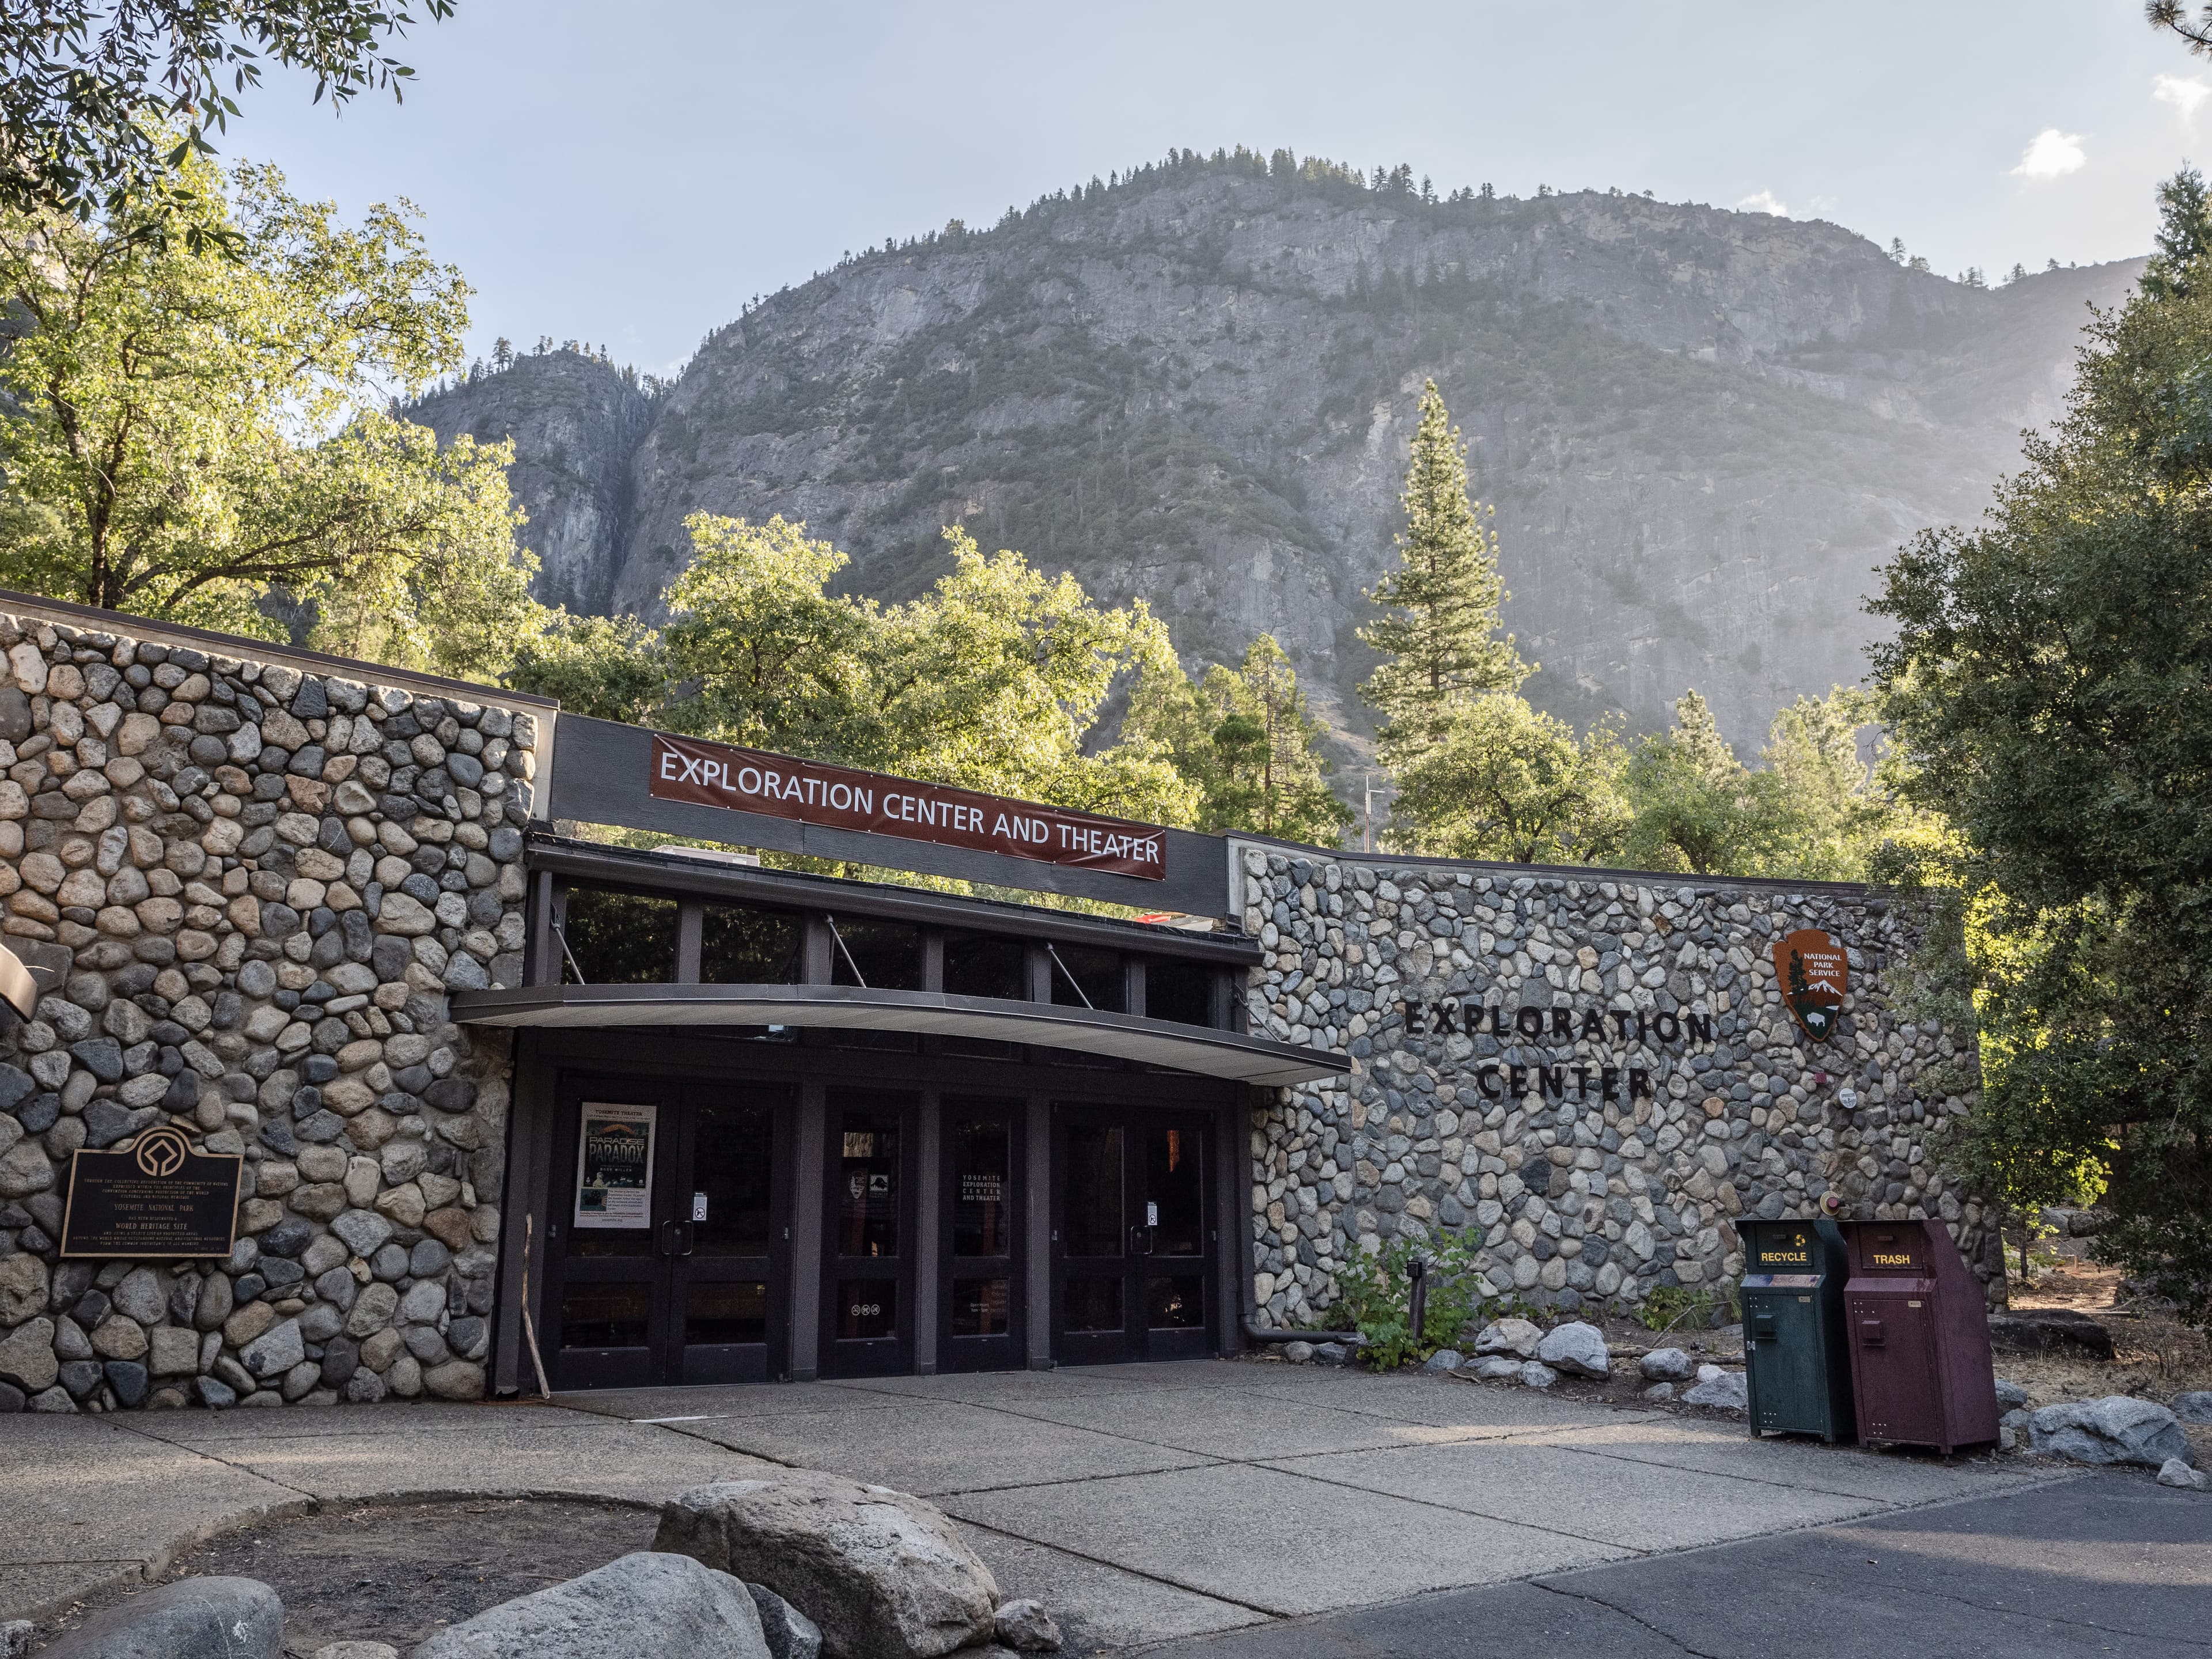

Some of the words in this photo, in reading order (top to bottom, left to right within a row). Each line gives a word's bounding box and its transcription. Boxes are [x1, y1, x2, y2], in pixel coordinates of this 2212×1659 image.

[660, 752, 872, 814] EXPLORATION
[883, 793, 984, 834] CENTER
[992, 813, 1049, 843] AND
[1056, 824, 1159, 863] THEATER
[1804, 953, 1842, 961] NATIONAL
[1404, 1002, 1712, 1043] EXPLORATION
[1478, 1064, 1652, 1098] CENTER
[589, 1144, 645, 1164] PARADOX
[1761, 1252, 1807, 1262] RECYCLE
[1874, 1255, 1910, 1264] TRASH
